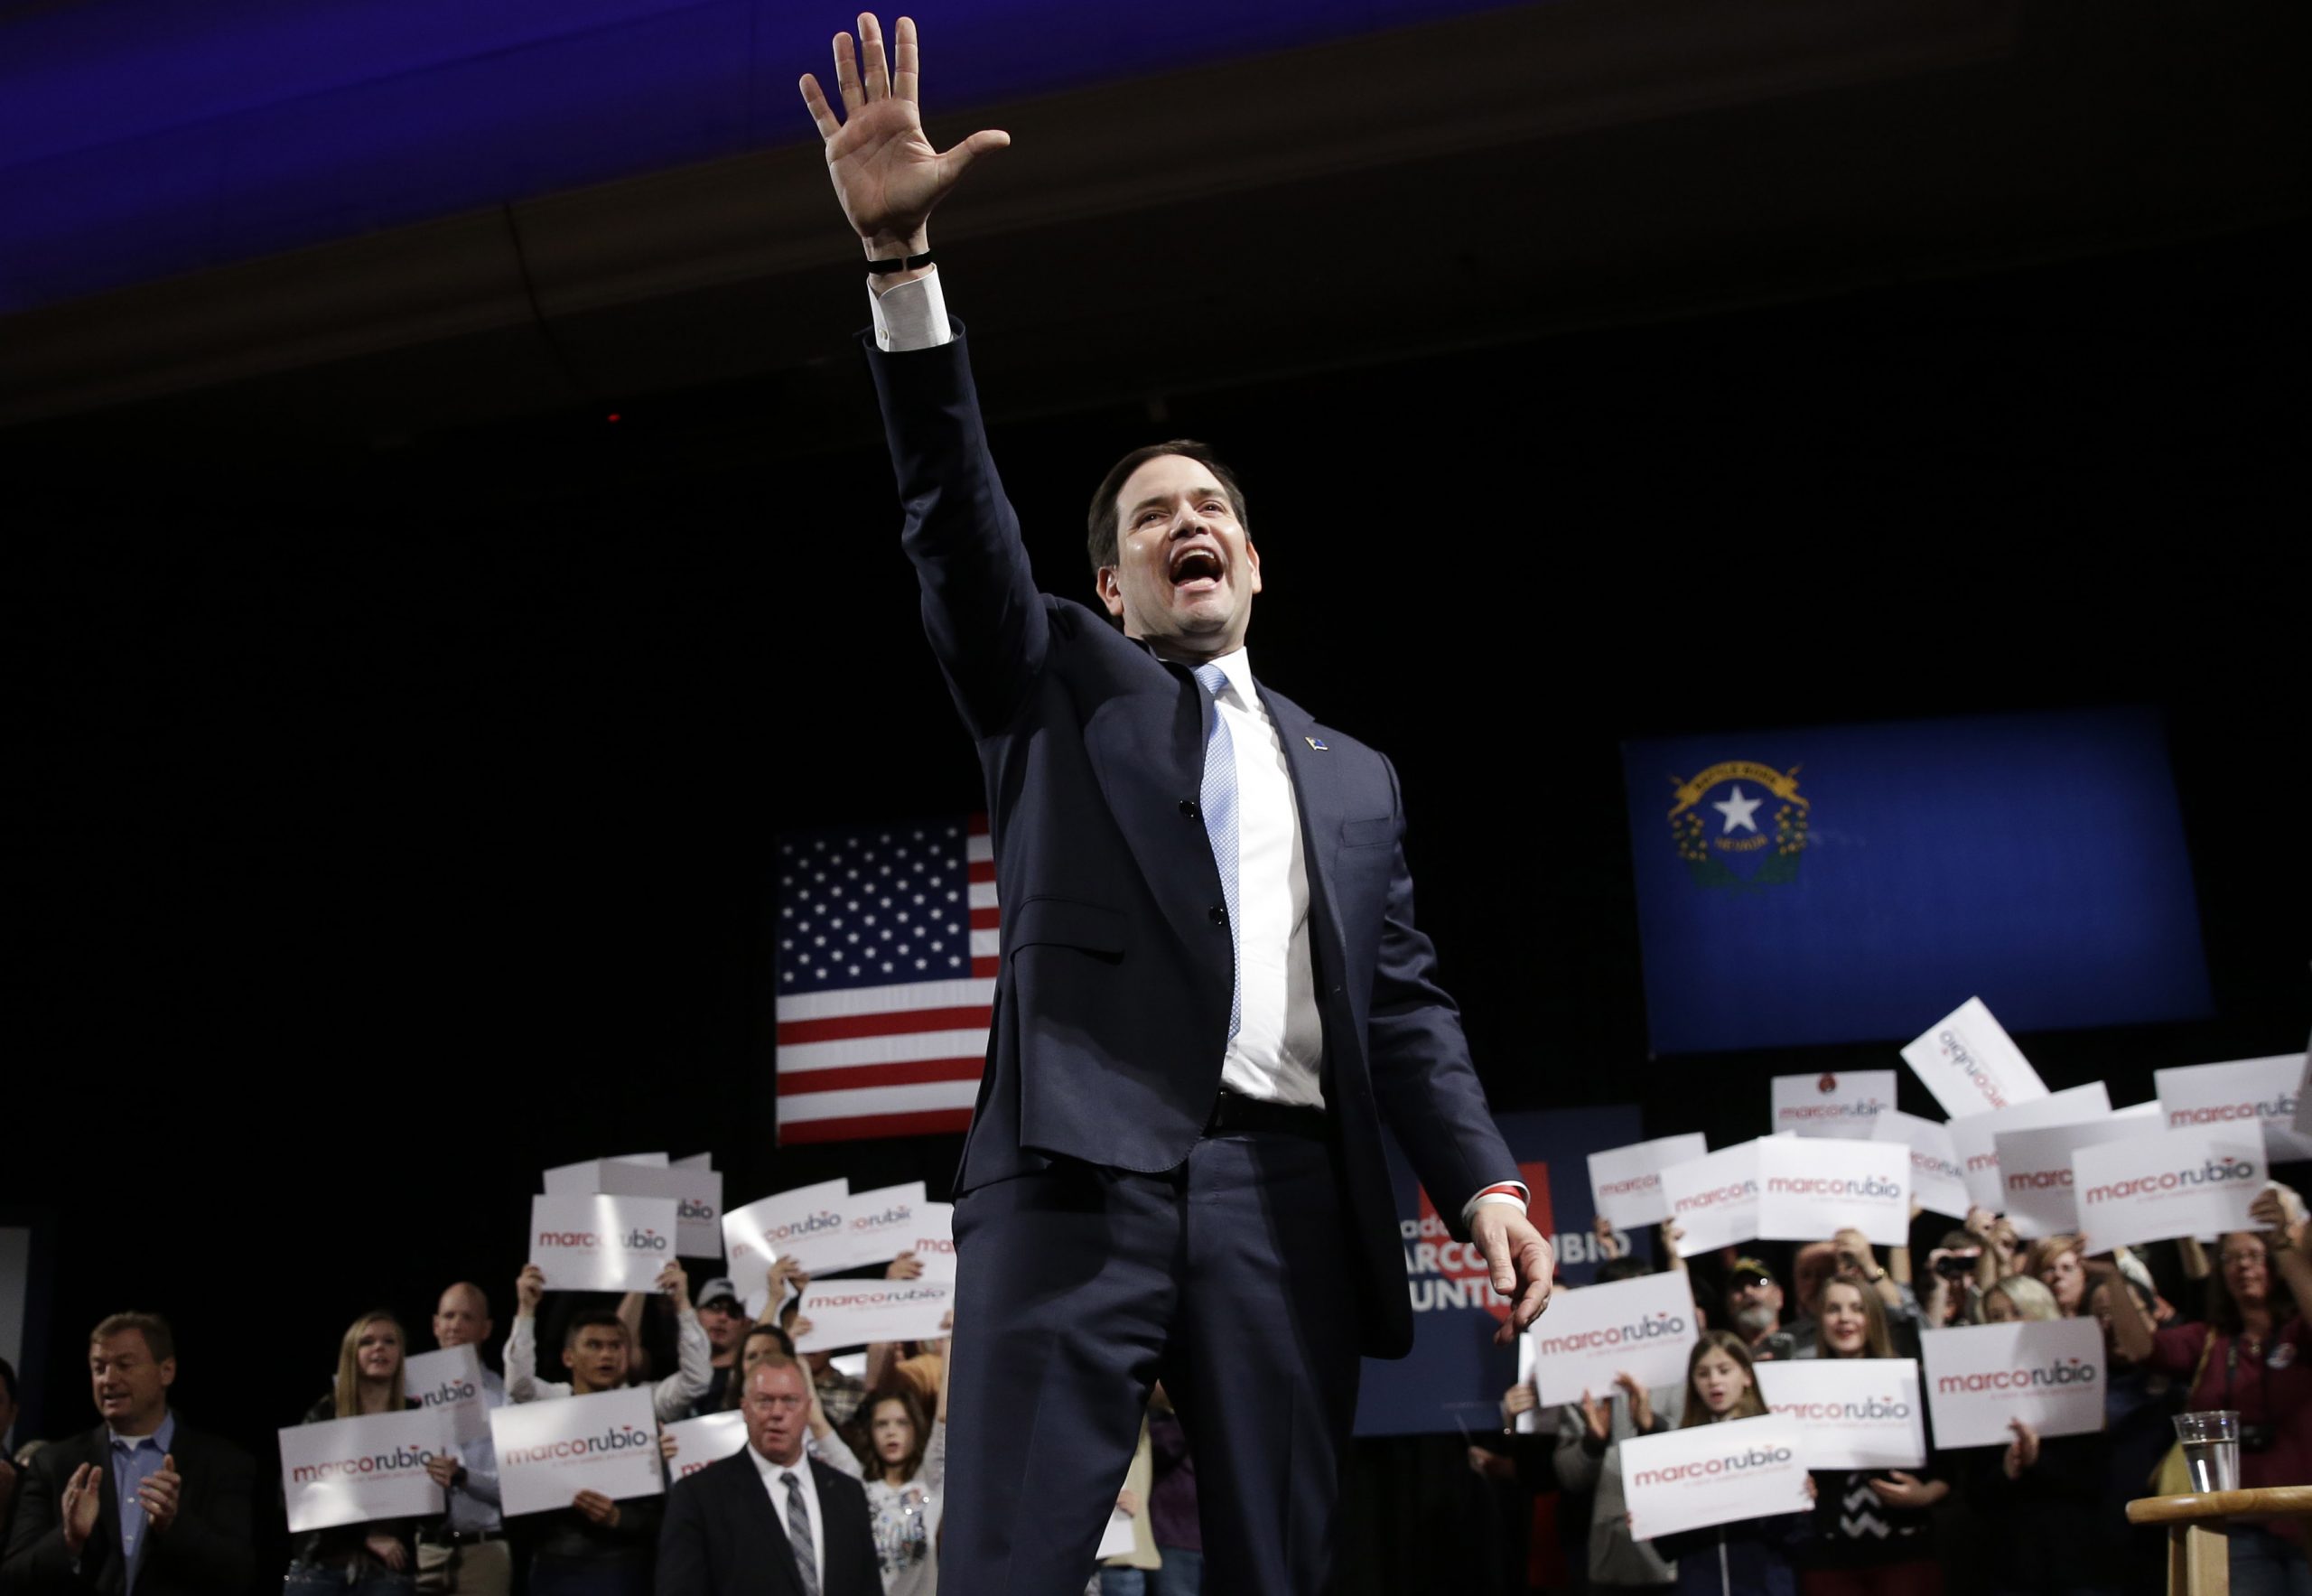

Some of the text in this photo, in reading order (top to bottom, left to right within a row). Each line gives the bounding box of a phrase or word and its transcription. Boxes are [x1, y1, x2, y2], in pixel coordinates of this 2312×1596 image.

[2169, 1091, 2299, 1127] marcorub
[1767, 1175, 1901, 1199] marcorubio
[2085, 1156, 2254, 1205] marcorubio
[808, 1288, 946, 1308] marcorubio
[1541, 1312, 1685, 1356] marcorubio
[1937, 1358, 2096, 1395] marcorubio
[293, 1444, 434, 1483] marcorubio
[505, 1424, 648, 1467] marcorubio
[1634, 1445, 1792, 1488] marcorubio
